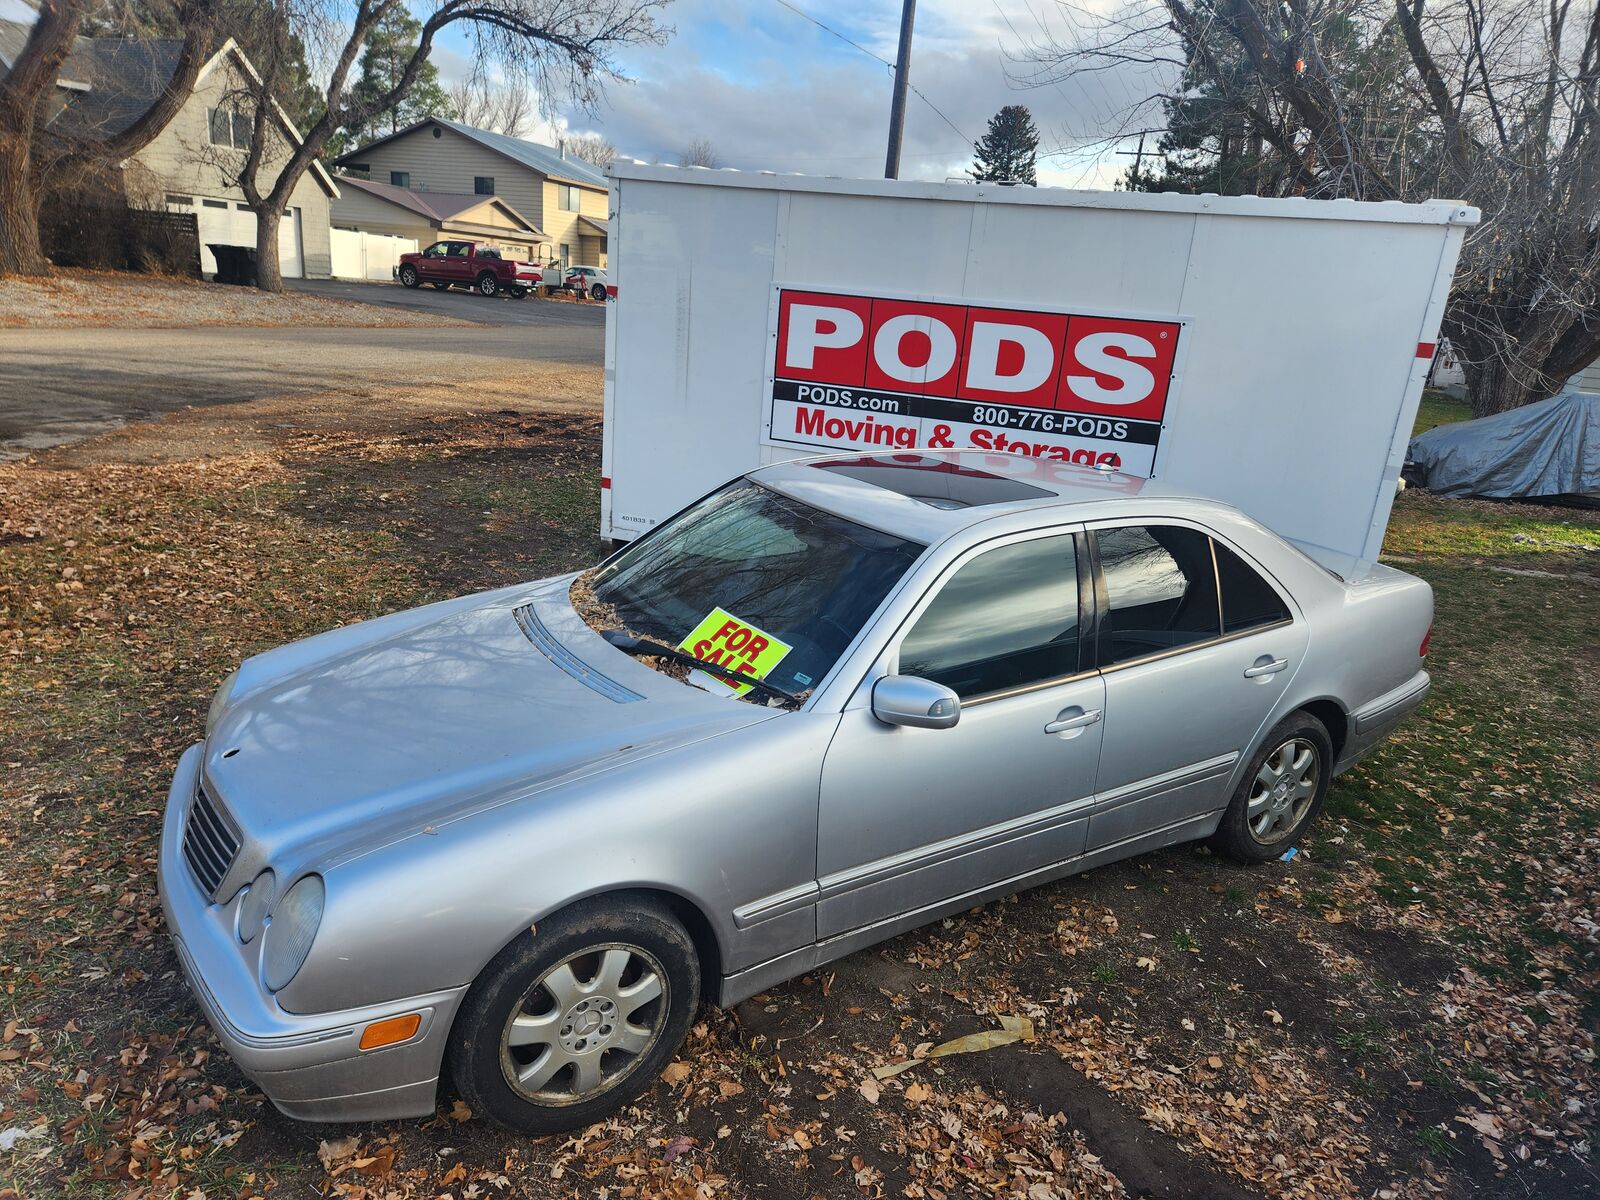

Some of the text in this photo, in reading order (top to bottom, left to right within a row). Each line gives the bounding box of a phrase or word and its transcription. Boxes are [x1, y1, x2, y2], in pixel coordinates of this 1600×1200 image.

[785, 302, 1158, 405] PODS
[795, 406, 917, 450] Moving
[927, 423, 955, 449] &
[797, 385, 1129, 440] PODS.com 800-776-PODS
[710, 619, 770, 664] FOR
